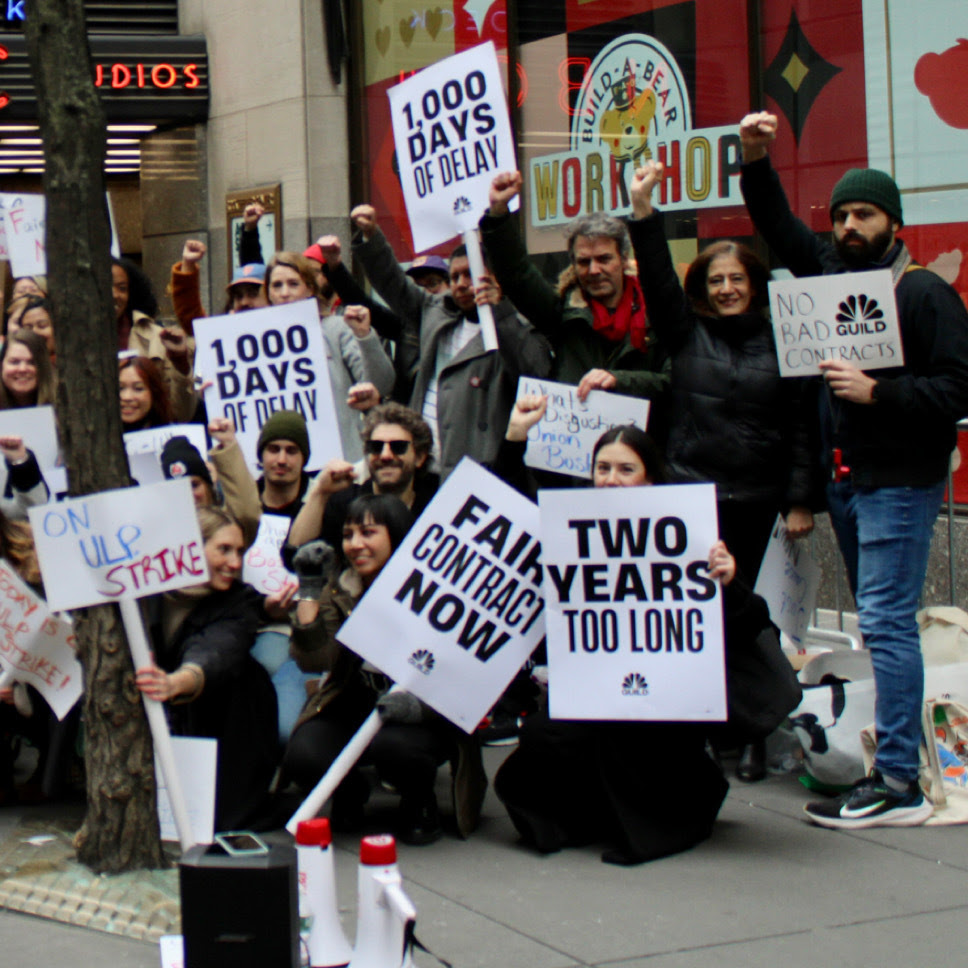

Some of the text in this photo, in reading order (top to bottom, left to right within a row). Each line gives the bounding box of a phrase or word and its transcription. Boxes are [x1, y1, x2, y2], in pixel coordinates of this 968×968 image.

[402, 70, 486, 132] 1,000
[582, 57, 678, 143] BUILD-A-BEAR
[408, 102, 496, 164] DAYS
[414, 135, 499, 198] OF DELAY
[533, 133, 742, 220] WORKHOP
[777, 292, 814, 318] NO
[211, 325, 309, 371] 1,000
[781, 320, 830, 344] BAD
[836, 321, 886, 336] GUILD
[785, 341, 895, 368] CONTRACTS
[217, 357, 315, 400] DAYS
[224, 402, 247, 432] OF
[43, 504, 89, 538] ON
[568, 516, 688, 559] TWO
[96, 541, 204, 597] STRIKE
[412, 523, 545, 636] CONTRACT
[546, 560, 717, 603] YEARS
[394, 568, 512, 664] NOW
[563, 608, 704, 653] TOO LONG
